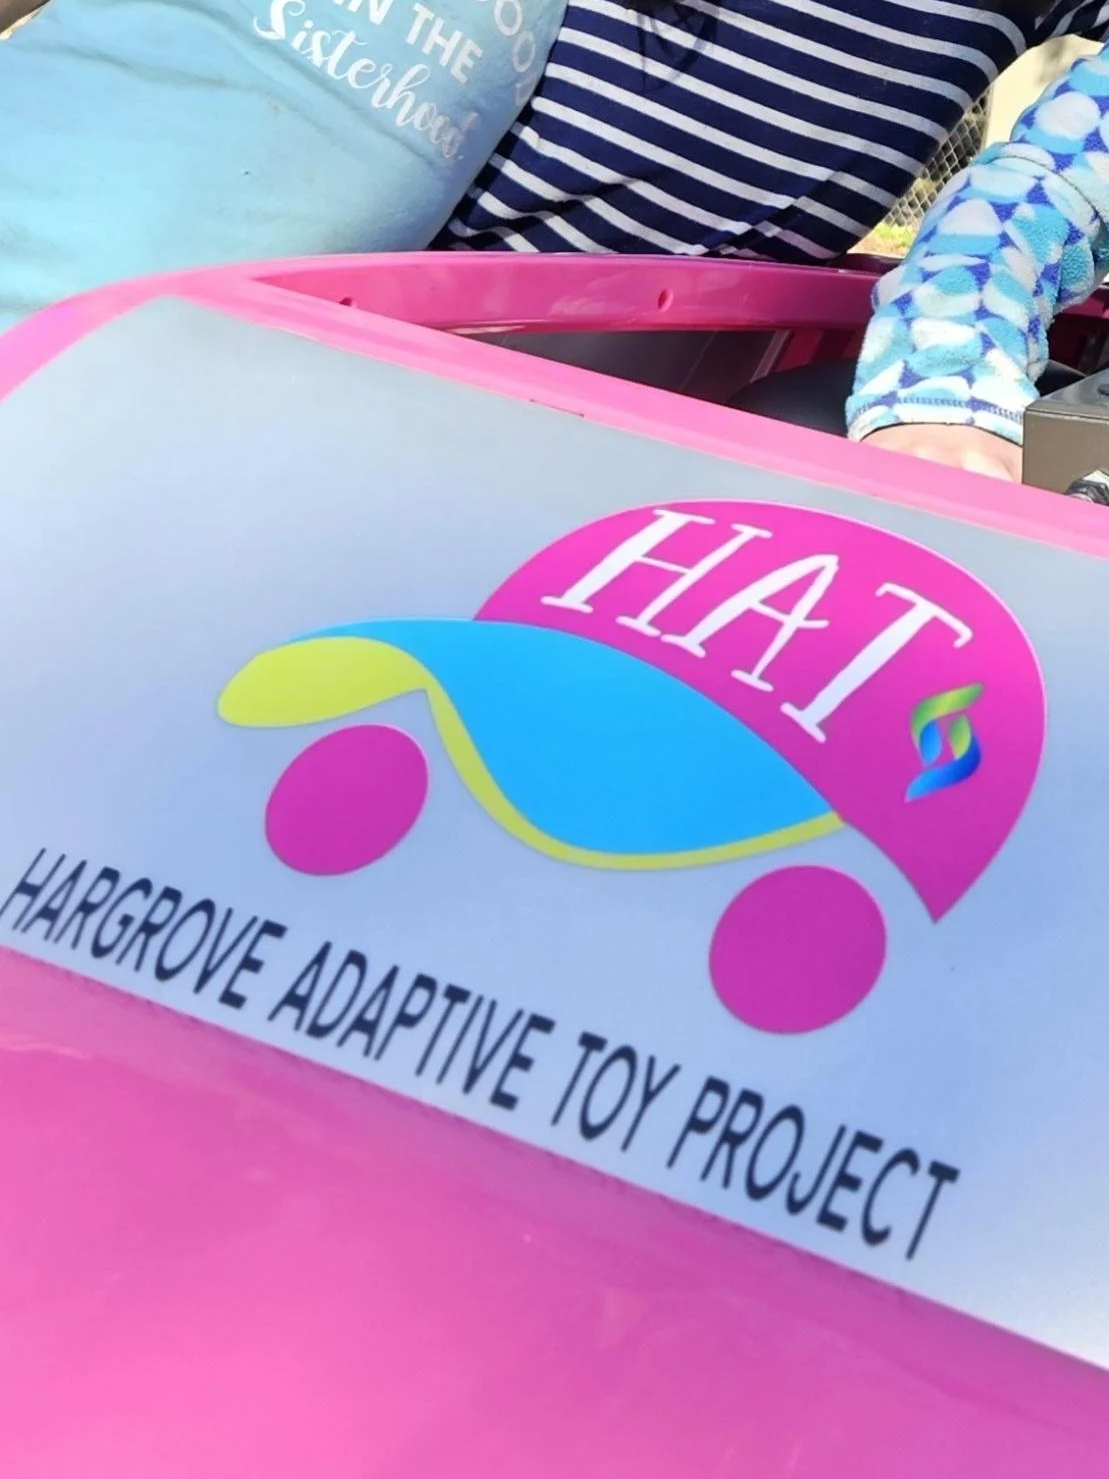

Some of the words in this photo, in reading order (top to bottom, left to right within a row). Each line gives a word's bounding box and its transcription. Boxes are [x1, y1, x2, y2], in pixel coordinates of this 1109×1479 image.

[405, 2, 483, 84] THE
[0, 847, 286, 1009] HARGROVE
[267, 939, 555, 1111] ADAPTIVE
[550, 1031, 682, 1153] TOY
[666, 1076, 959, 1261] PROJECT
